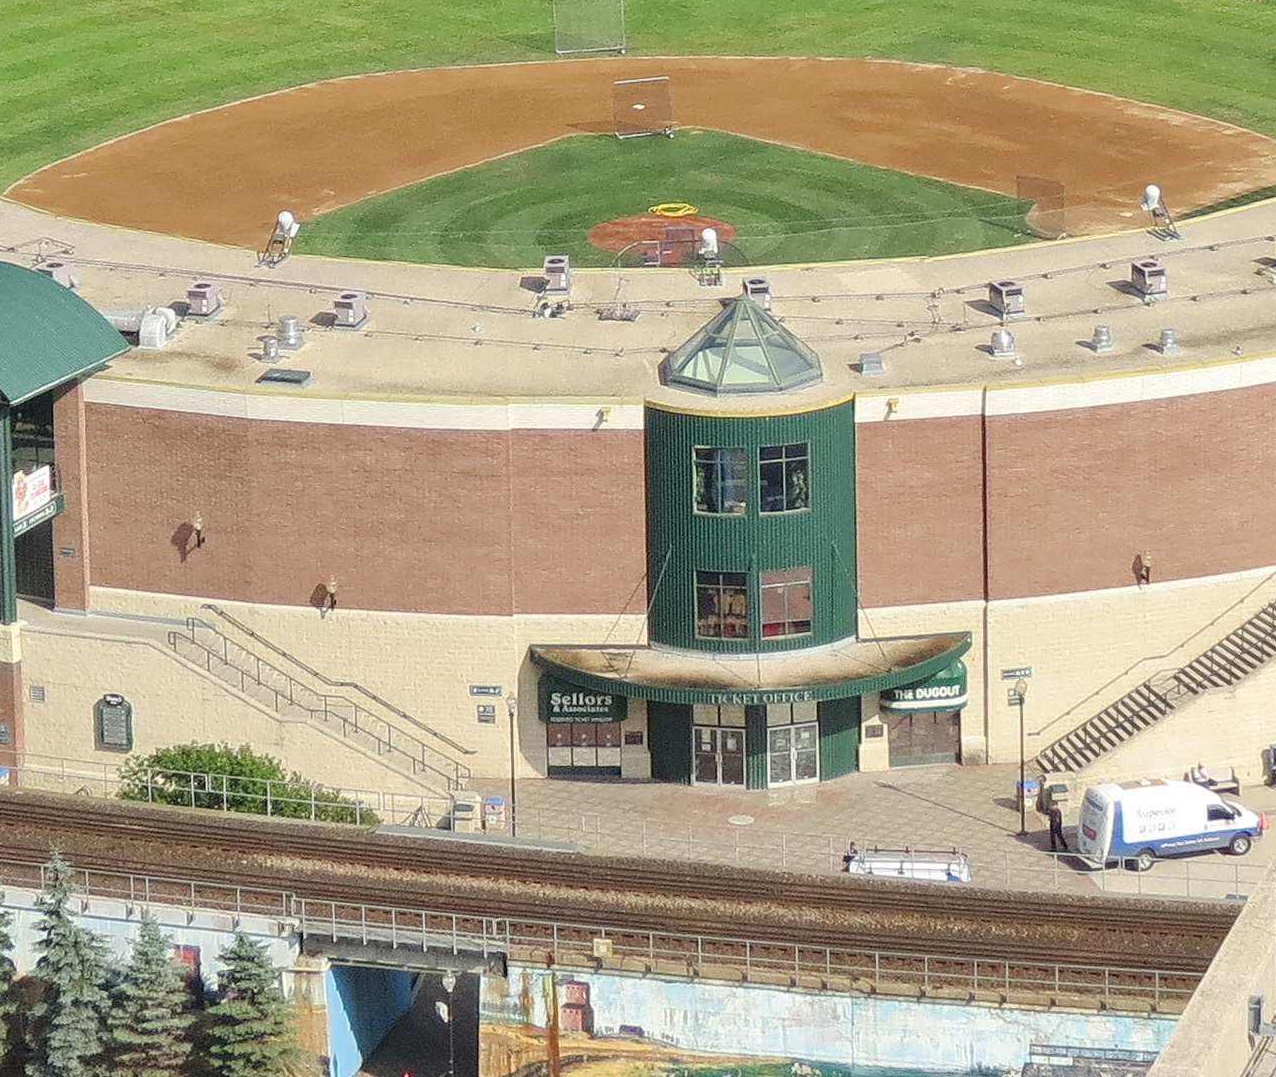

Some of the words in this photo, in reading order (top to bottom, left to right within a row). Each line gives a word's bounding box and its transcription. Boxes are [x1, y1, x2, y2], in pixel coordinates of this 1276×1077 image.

[550, 692, 613, 706] Sellors
[710, 692, 759, 705] TICKET
[762, 690, 813, 704] OFFICE
[893, 689, 914, 700] THE
[915, 685, 961, 699] DUGOUT
[552, 705, 560, 713] &
[561, 705, 609, 713] Associates
[1137, 808, 1176, 819] Superior
